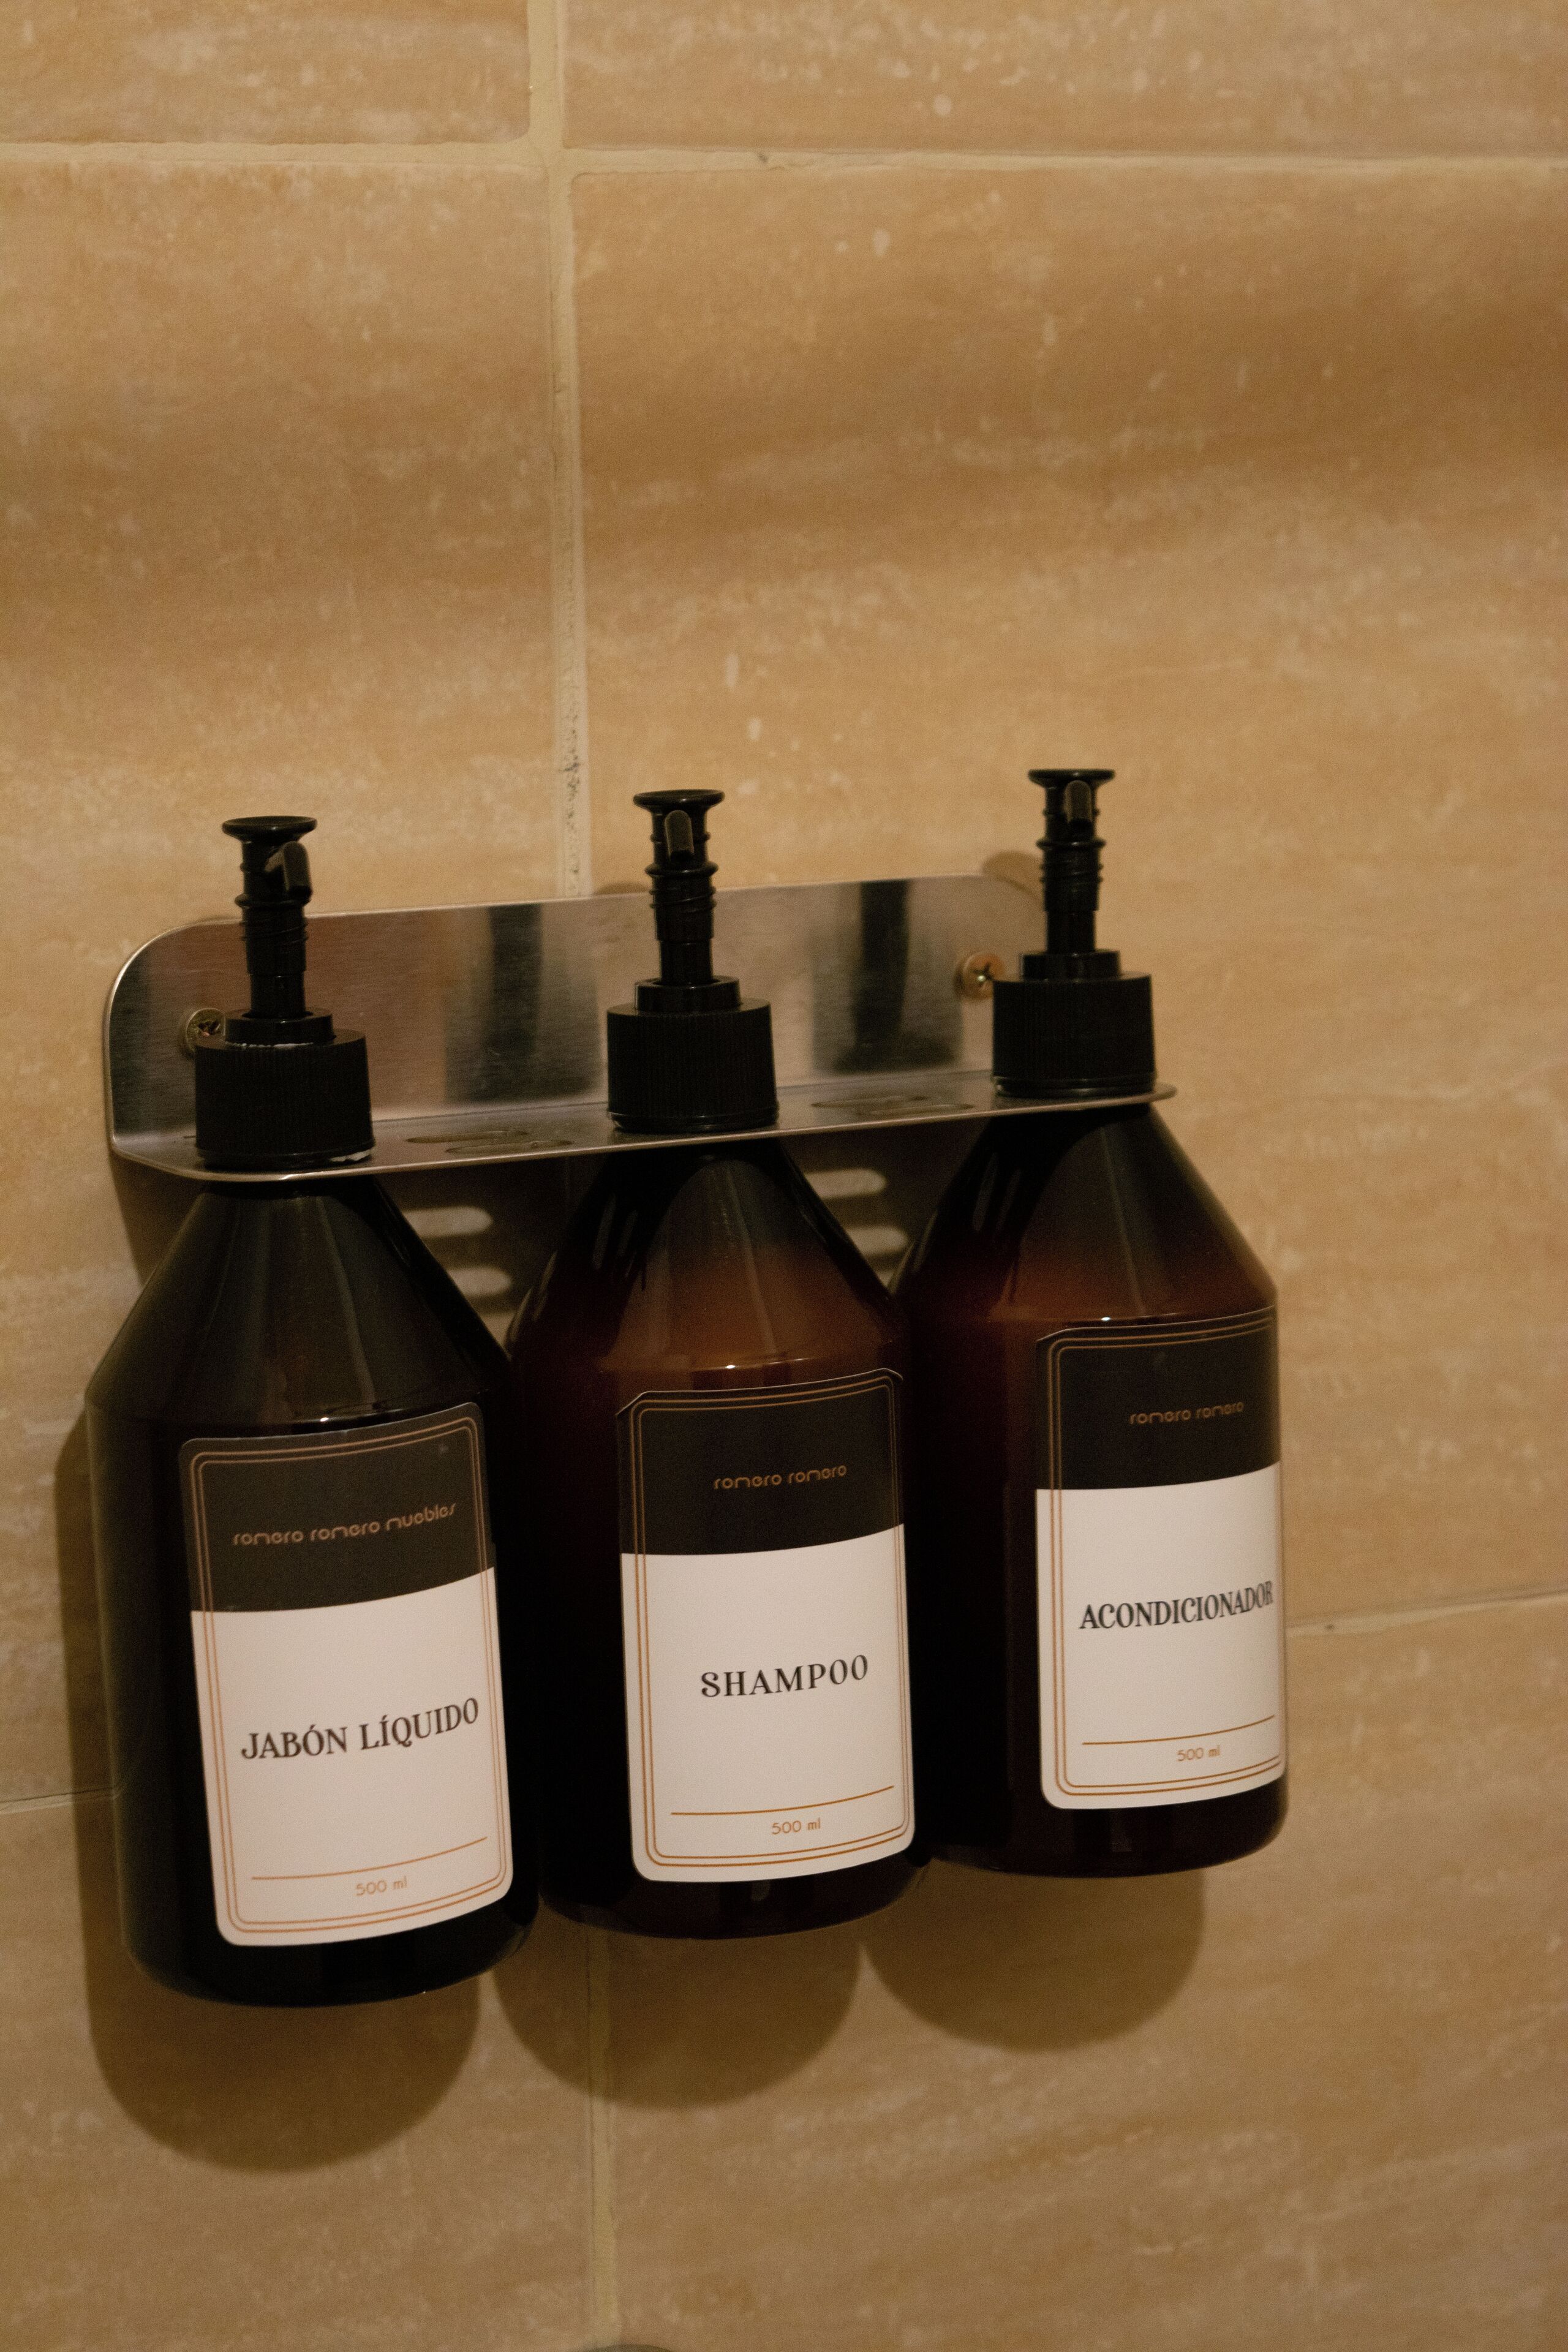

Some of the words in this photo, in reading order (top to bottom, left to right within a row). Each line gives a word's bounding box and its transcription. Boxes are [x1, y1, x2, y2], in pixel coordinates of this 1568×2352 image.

[1129, 1410, 1191, 1425] romero
[1196, 1401, 1244, 1419] romero
[714, 1474, 782, 1489] romero
[787, 1464, 847, 1483] romero
[233, 1529, 304, 1546] romero
[310, 1520, 380, 1542] romero
[386, 1503, 456, 1531] muebles
[1079, 1580, 1273, 1630] ACONDICIONADOR
[701, 1654, 869, 1698] SHAMPOO
[241, 1724, 347, 1760] JABÓN
[360, 1697, 479, 1751] LÍQUIDO
[1178, 1747, 1204, 1762] 500
[1208, 1745, 1221, 1757] ml
[772, 1820, 802, 1835] 500
[807, 1817, 821, 1830] ml
[356, 1880, 386, 1896] 500
[393, 1875, 407, 1890] ml
